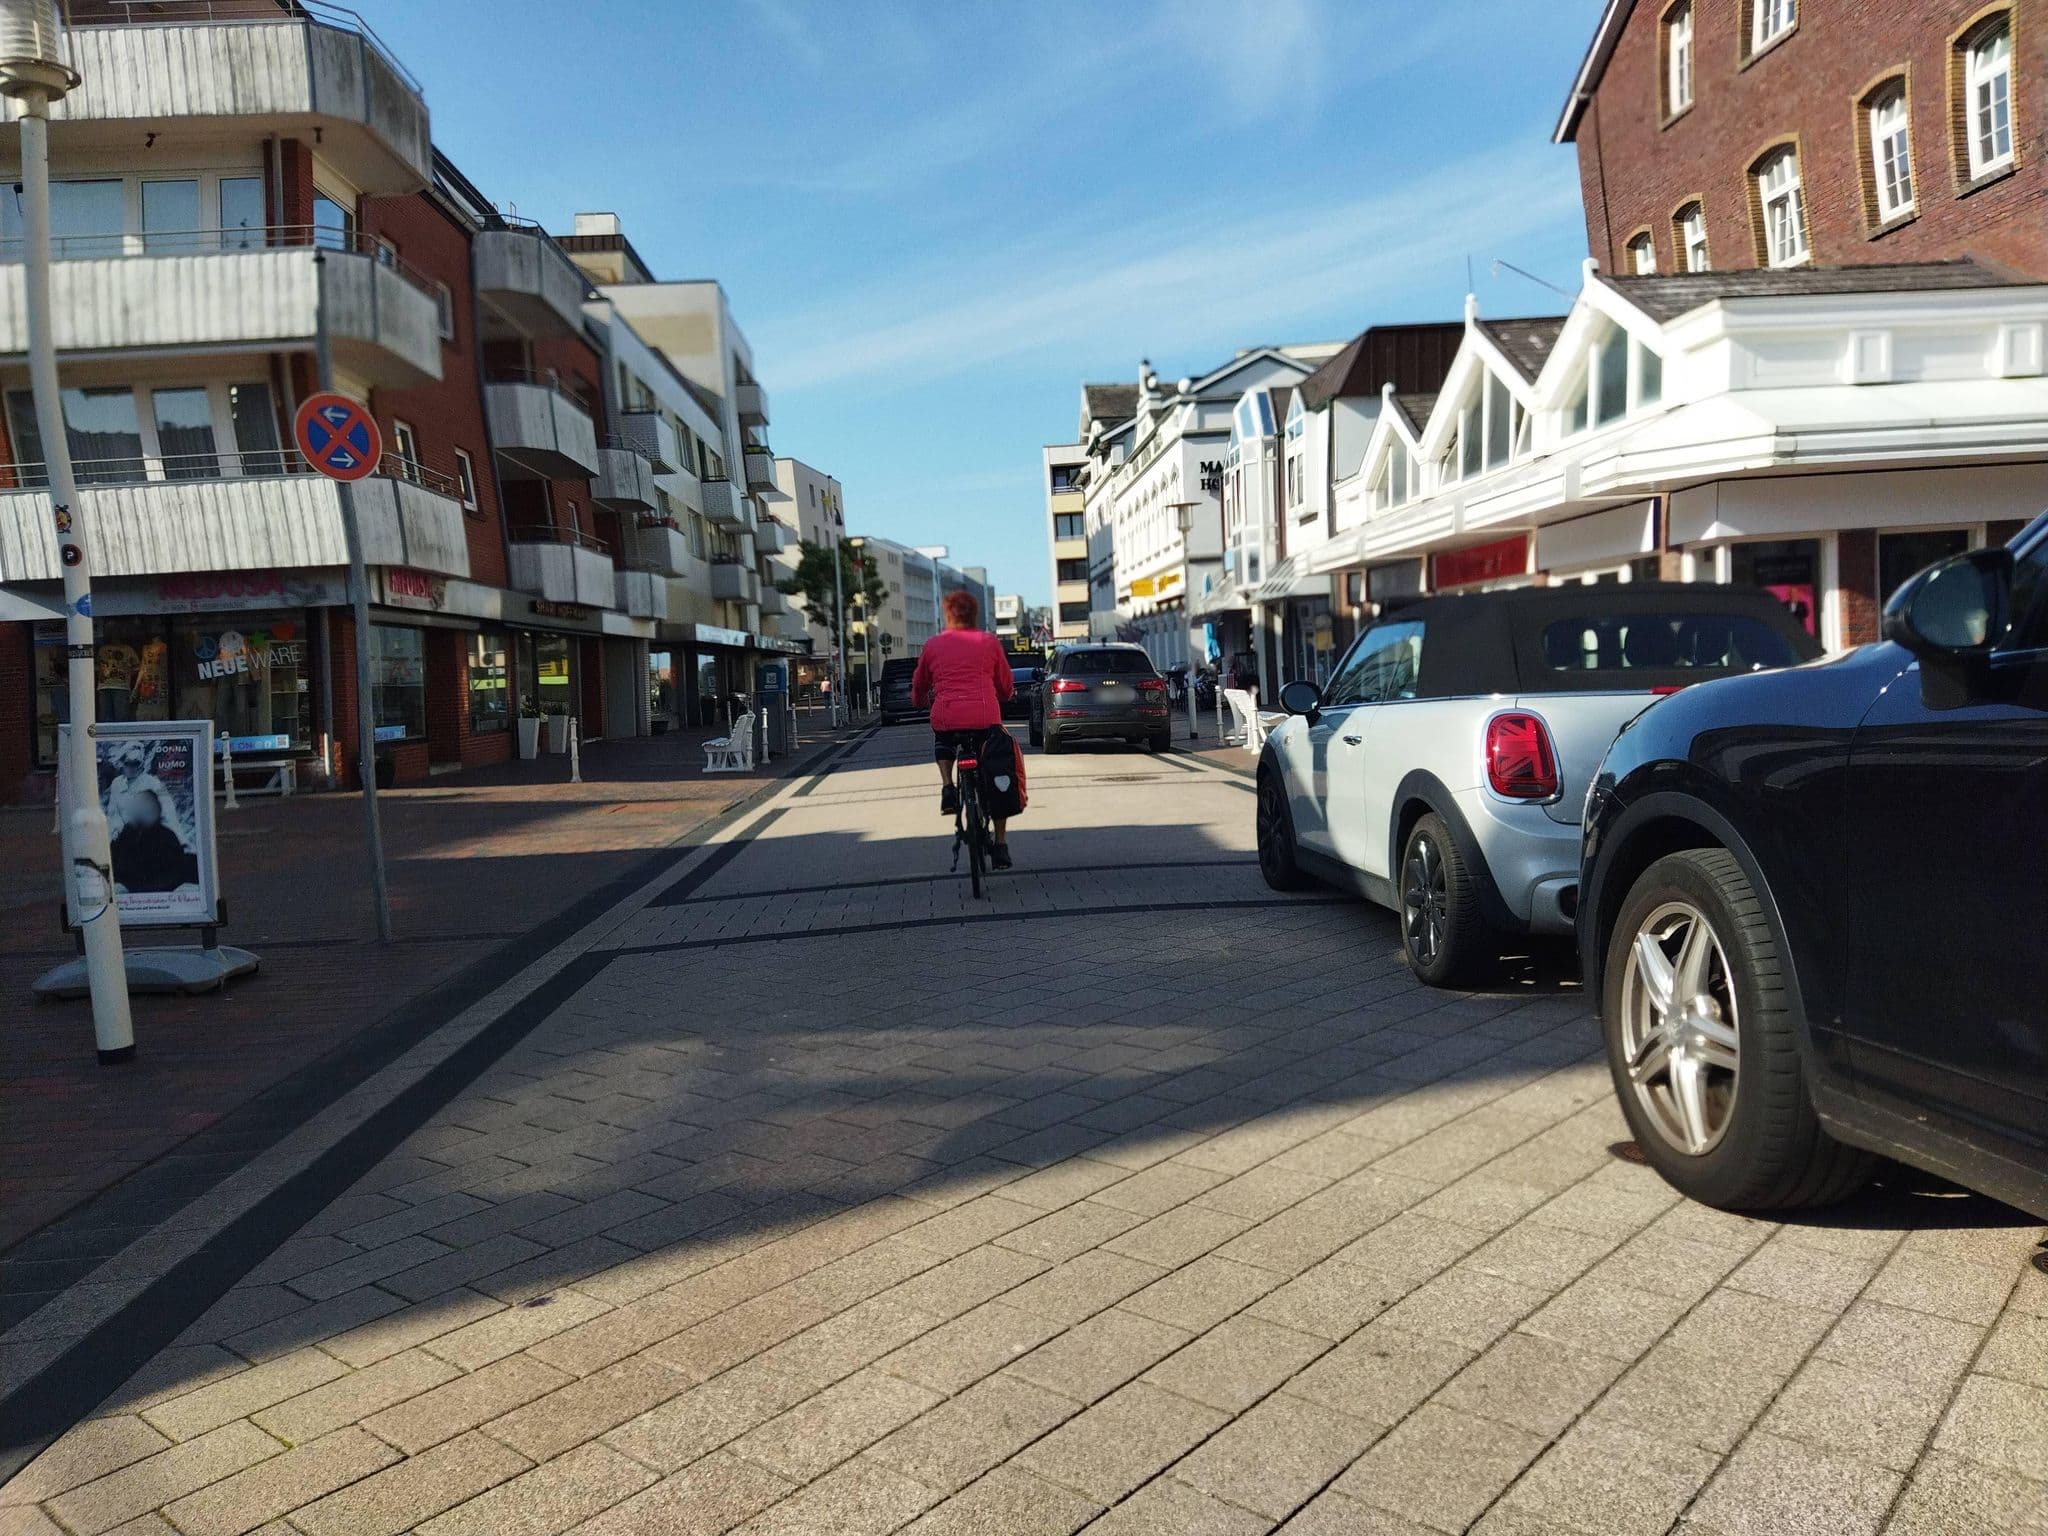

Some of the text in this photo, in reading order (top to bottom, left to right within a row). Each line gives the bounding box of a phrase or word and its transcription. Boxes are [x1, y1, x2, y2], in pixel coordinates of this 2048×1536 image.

[198, 644, 302, 680] NEUE WARE
[156, 745, 187, 754] DONNA
[158, 760, 186, 769] UOMO
